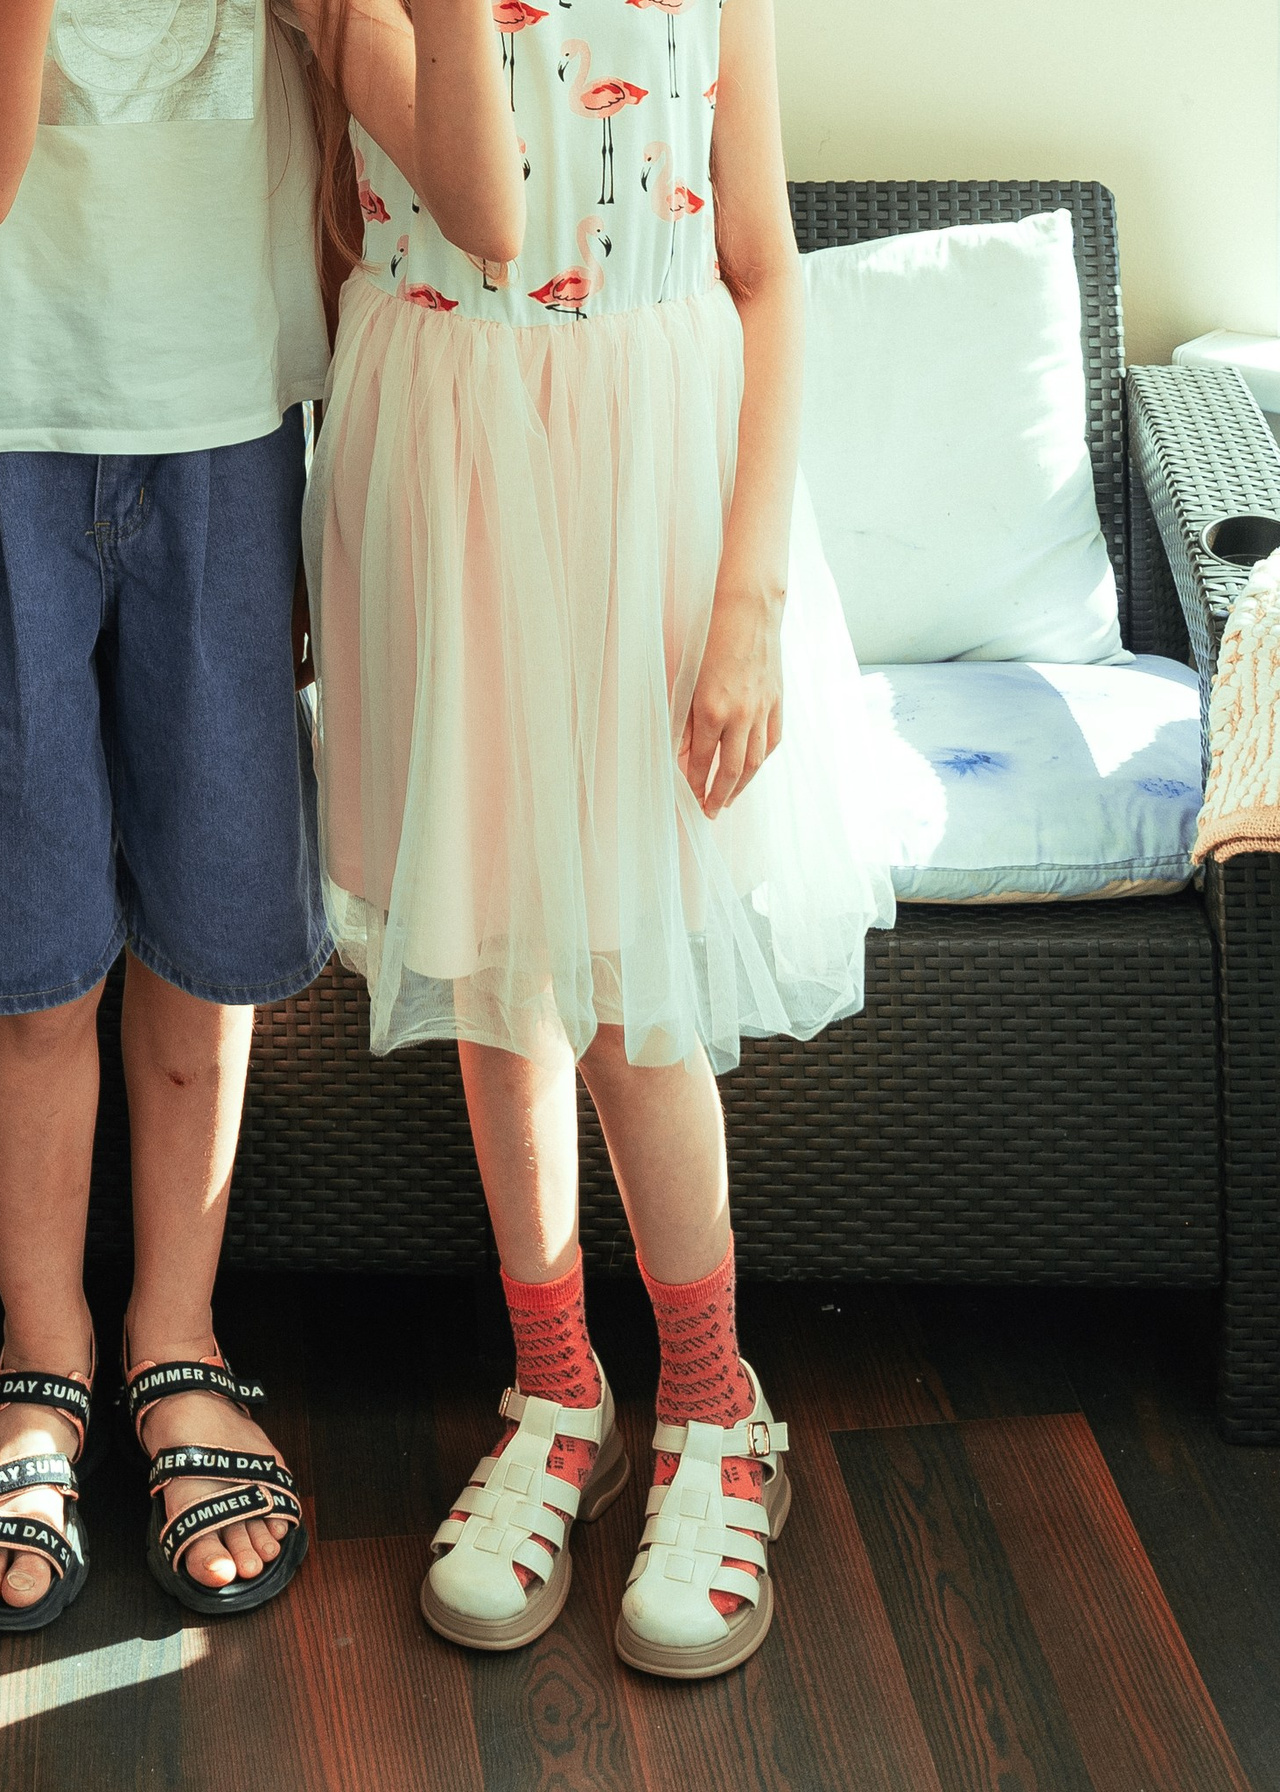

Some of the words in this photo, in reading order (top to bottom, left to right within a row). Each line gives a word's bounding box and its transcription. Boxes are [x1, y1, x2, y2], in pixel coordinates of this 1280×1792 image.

[3, 1380, 38, 1393] DAY
[192, 1453, 230, 1469] SUN
[236, 1457, 274, 1472] DAY
[176, 1493, 252, 1536] SUMMER
[22, 1524, 59, 1553] DAY
